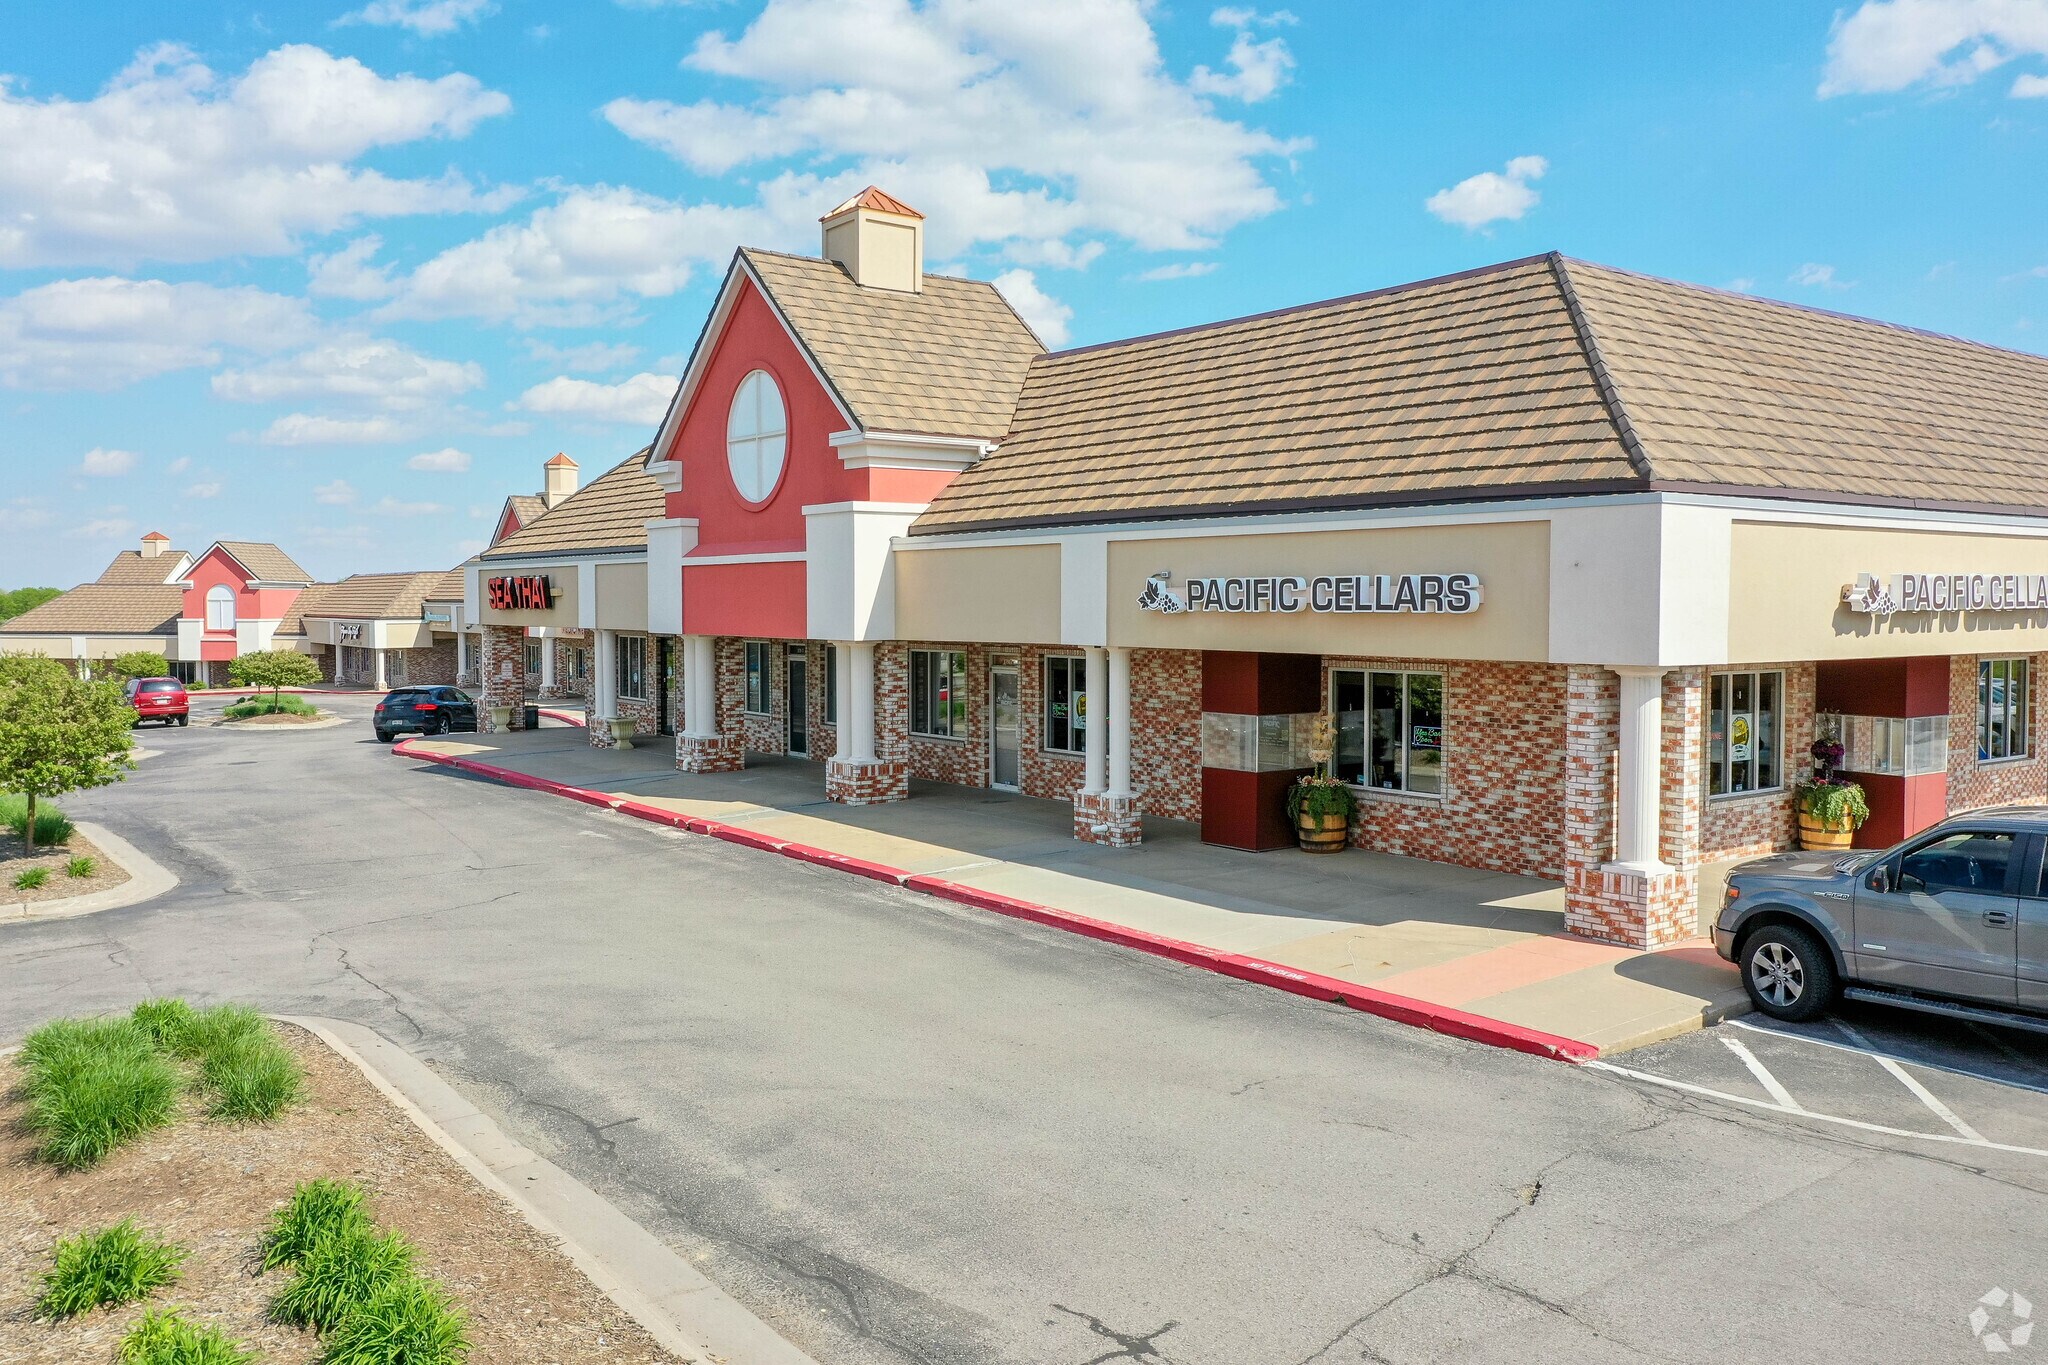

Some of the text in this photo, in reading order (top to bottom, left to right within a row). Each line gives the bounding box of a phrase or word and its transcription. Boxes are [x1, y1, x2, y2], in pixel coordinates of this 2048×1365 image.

[488, 576, 547, 609] SEA THAI
[1186, 574, 1473, 613] PACIFIC CELLARS
[1901, 574, 2048, 610] PACIFIC CELLA
[1262, 966, 1307, 980] PARKING
